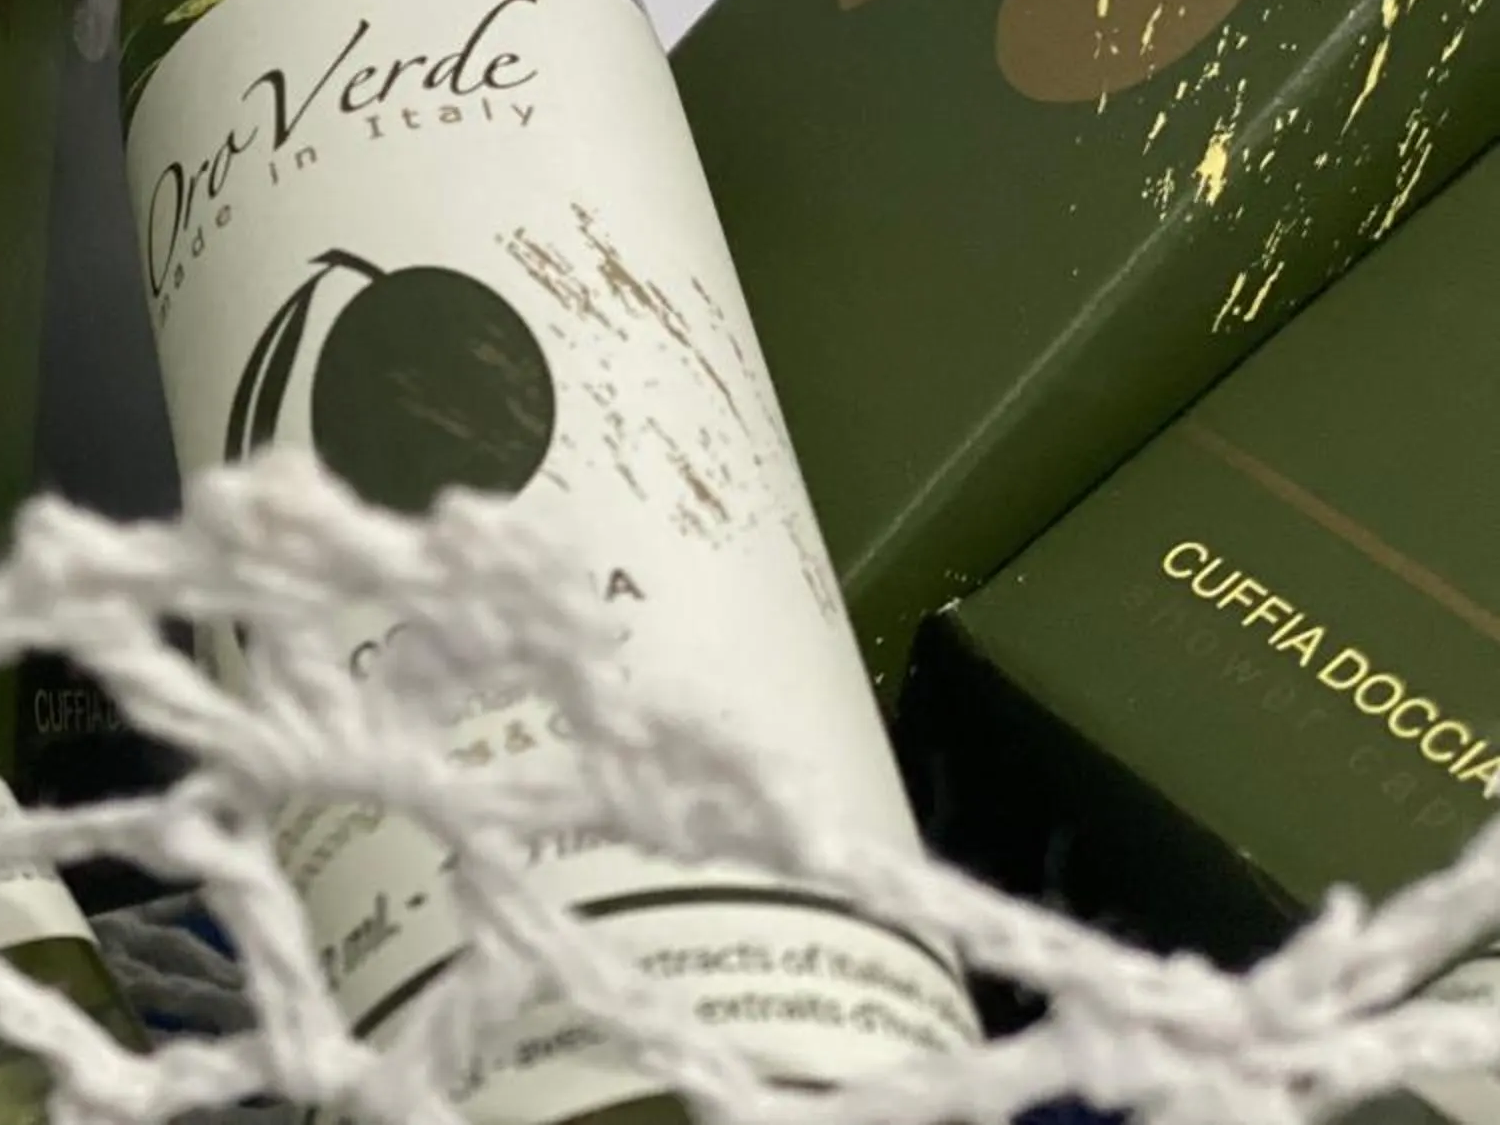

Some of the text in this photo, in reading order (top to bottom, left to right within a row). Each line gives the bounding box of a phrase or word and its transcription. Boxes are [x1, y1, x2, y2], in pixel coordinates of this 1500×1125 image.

[157, 95, 537, 329] made in Italy
[1121, 578, 1454, 835] shower cap
[1161, 539, 1500, 801] CUFFIA DOCCIA
